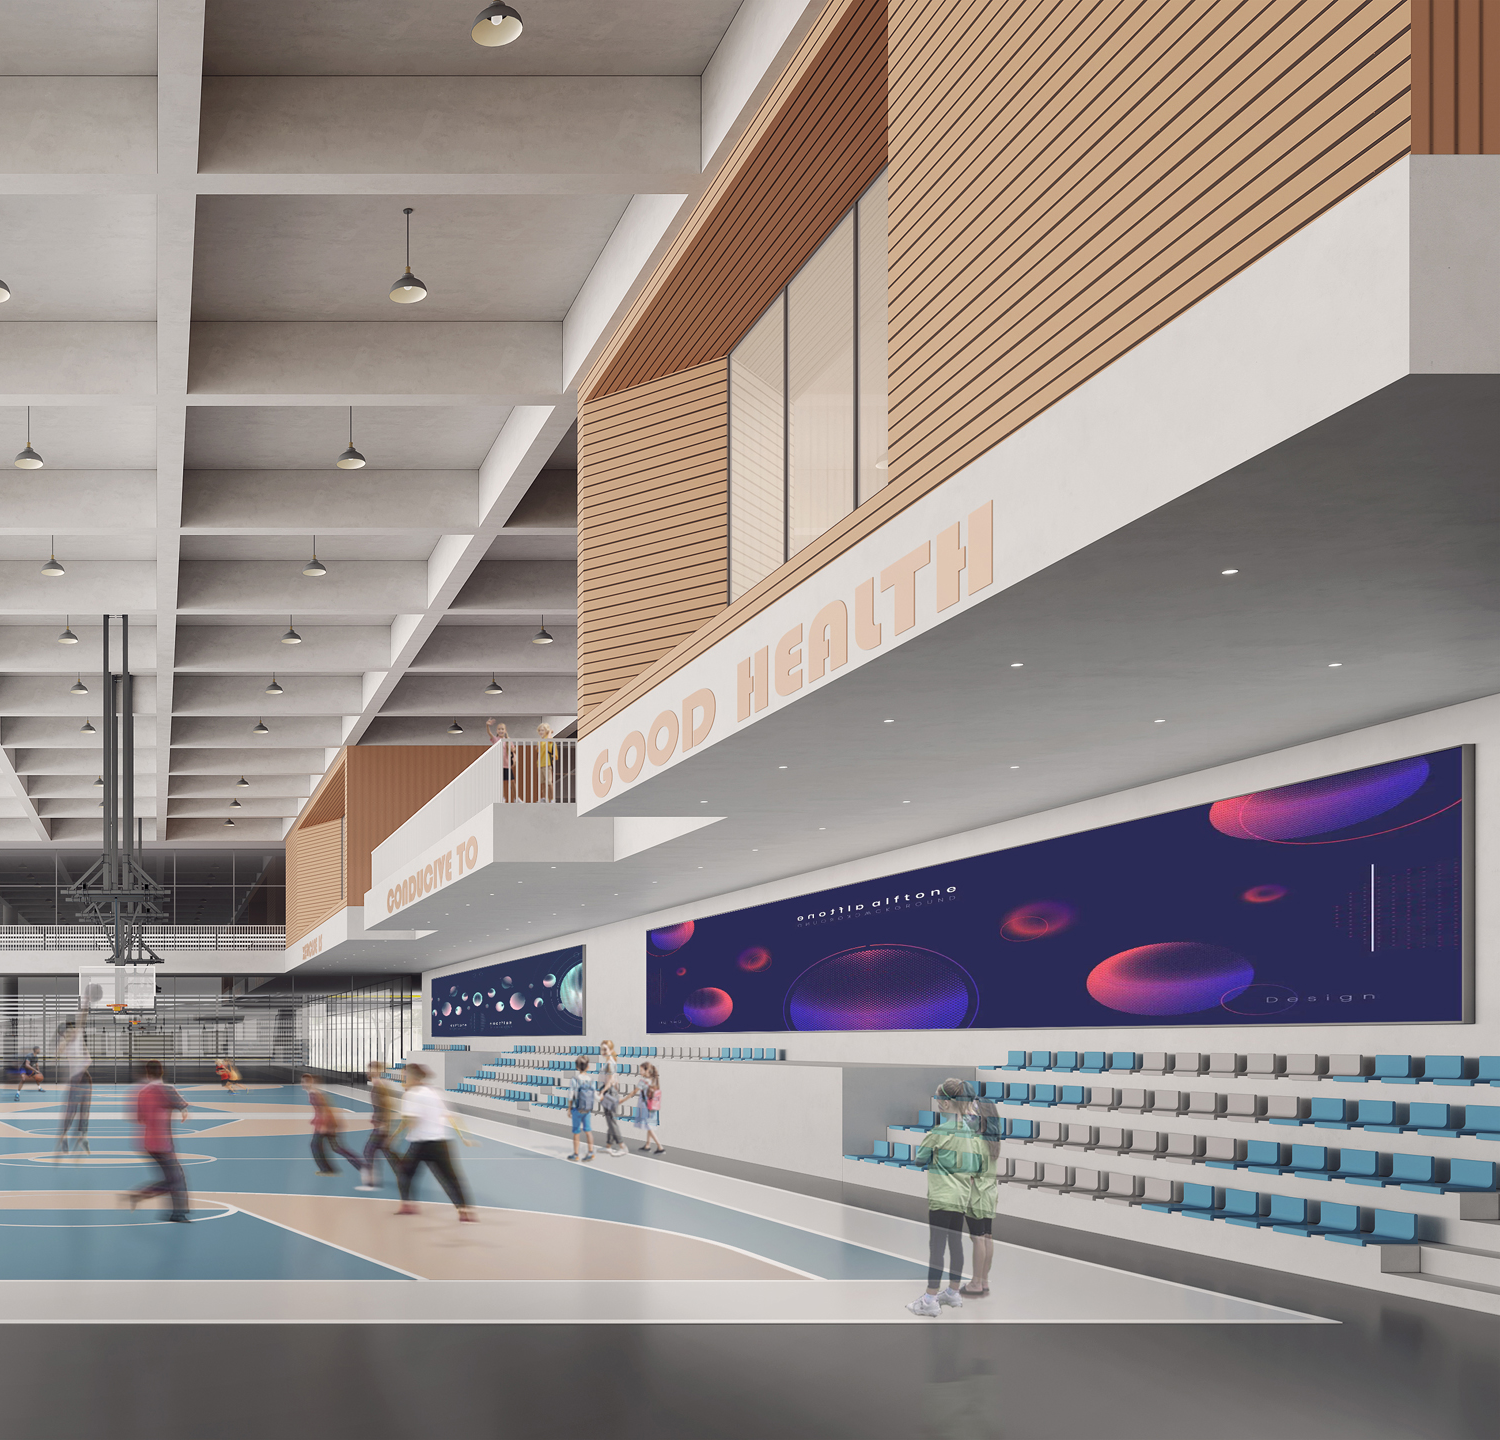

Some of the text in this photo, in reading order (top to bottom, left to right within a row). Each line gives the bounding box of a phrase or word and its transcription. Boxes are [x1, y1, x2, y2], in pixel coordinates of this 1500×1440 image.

[592, 499, 994, 799] GOOD HEALTH
[386, 835, 479, 914] CONDUCIVE TO
[1265, 993, 1376, 1003] Design
